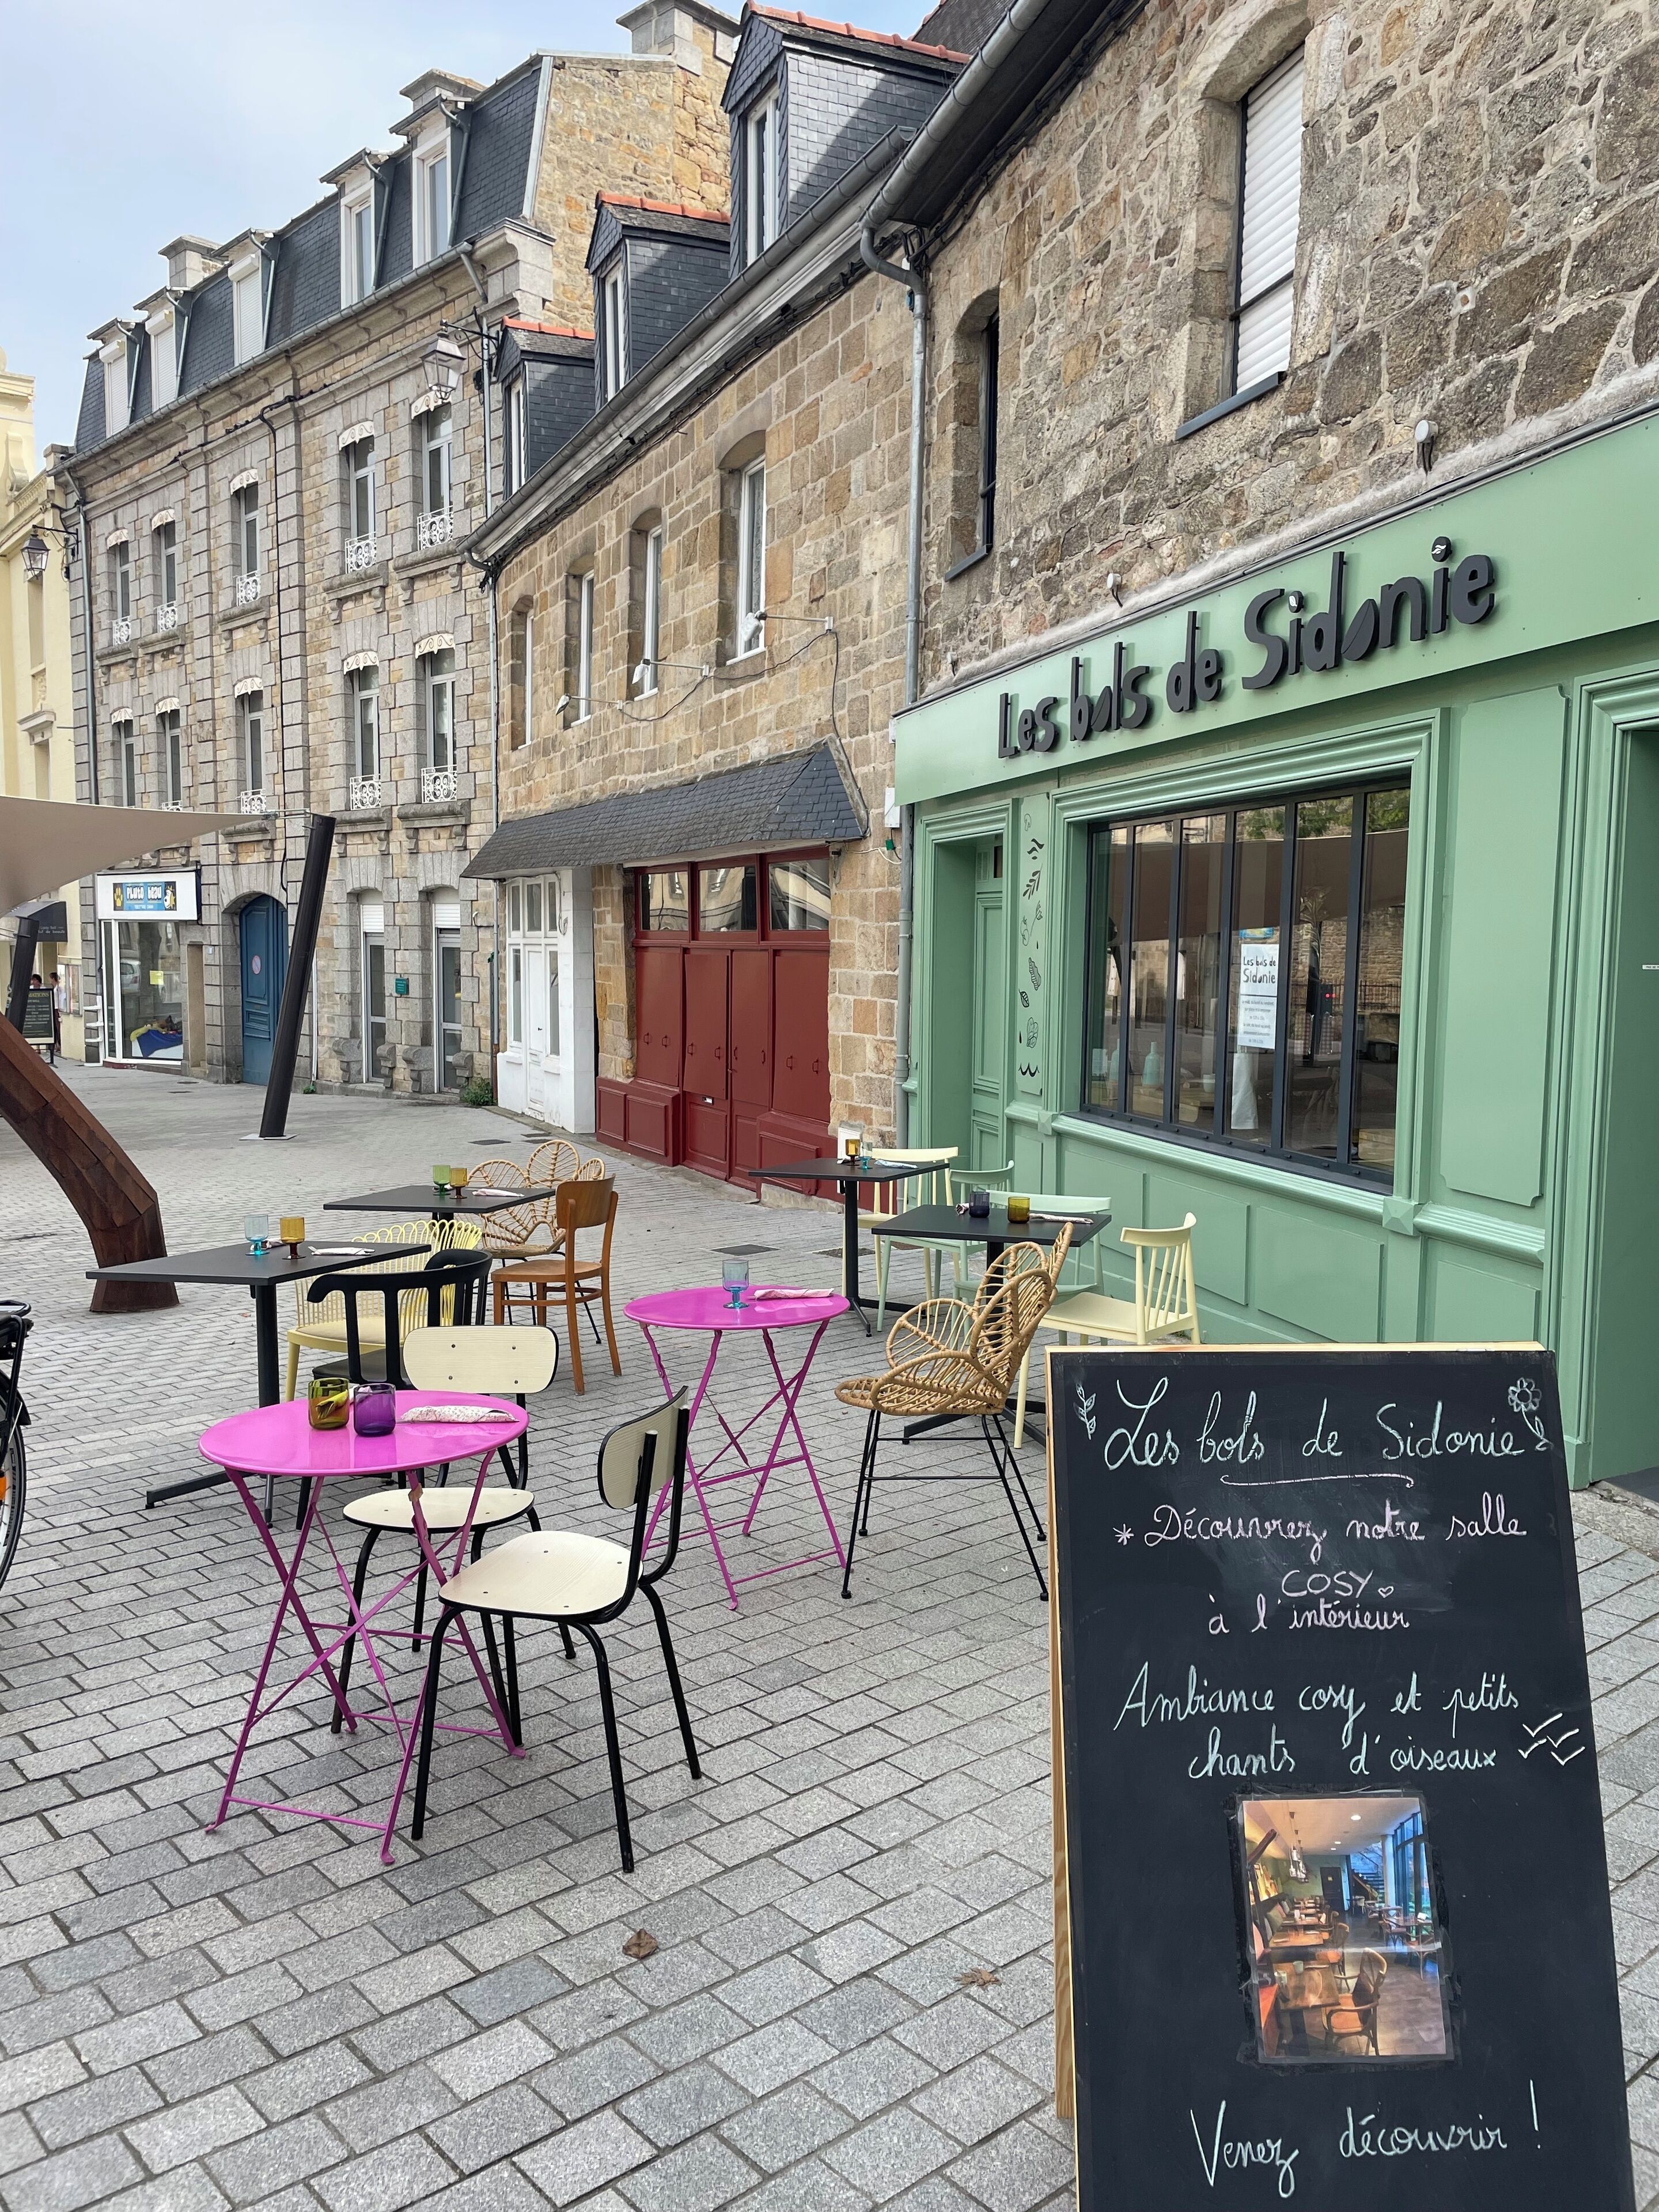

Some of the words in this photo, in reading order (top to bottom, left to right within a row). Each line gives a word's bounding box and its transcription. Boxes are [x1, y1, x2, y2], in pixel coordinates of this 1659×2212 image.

[998, 692, 1059, 758] Les
[1070, 642, 1150, 741] bols
[1166, 611, 1223, 713] de
[1241, 536, 1496, 690] Sidonie
[1243, 956, 1253, 966] Les
[1269, 956, 1276, 967] de
[1243, 967, 1276, 984] Sidonie
[1104, 1377, 1181, 1471] Les
[1199, 1390, 1266, 1464] bols
[1302, 1397, 1344, 1458] de
[1376, 1400, 1525, 1461] Sidonie
[1145, 1504, 1328, 1565] Découvrez
[1346, 1499, 1425, 1541] notre
[1445, 1492, 1527, 1541] salle
[1209, 1594, 1230, 1635] à
[1113, 1661, 1275, 1730] Ambiance
[1298, 1682, 1366, 1749] cosy
[1391, 1671, 1422, 1714] et
[1444, 1673, 1520, 1738] petits
[1188, 1724, 1296, 1779] chants
[1190, 2100, 1300, 2198] Venez
[1339, 2106, 1508, 2159] découvrir
